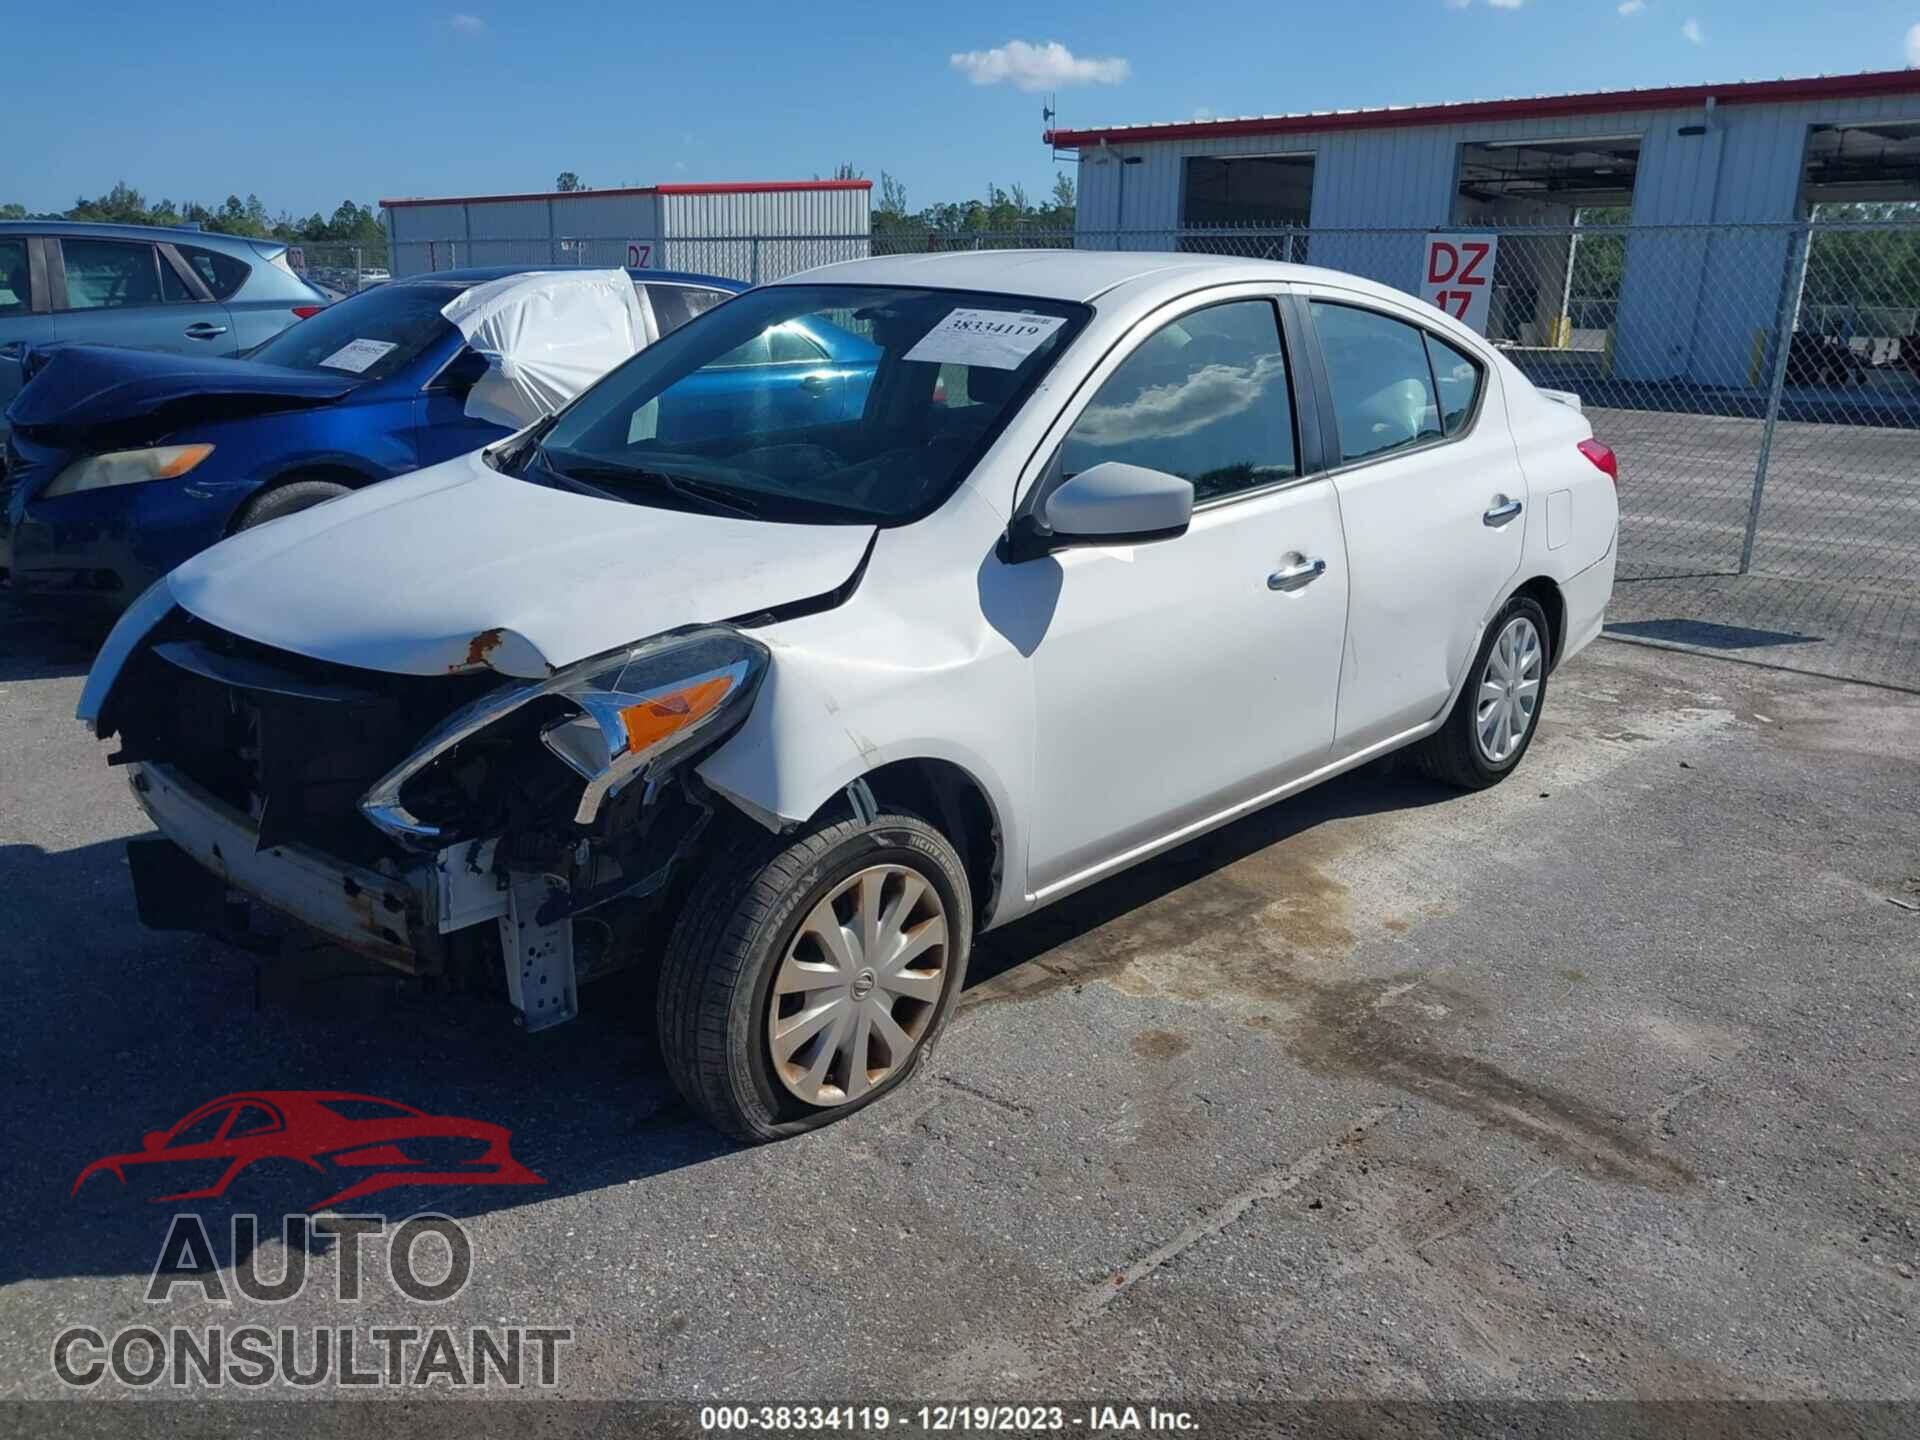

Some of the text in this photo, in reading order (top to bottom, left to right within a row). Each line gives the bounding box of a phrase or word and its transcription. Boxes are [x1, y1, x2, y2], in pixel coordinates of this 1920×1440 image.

[628, 245, 651, 269] DZ
[1428, 242, 1489, 285] DZ
[946, 319, 1040, 336] 38334119
